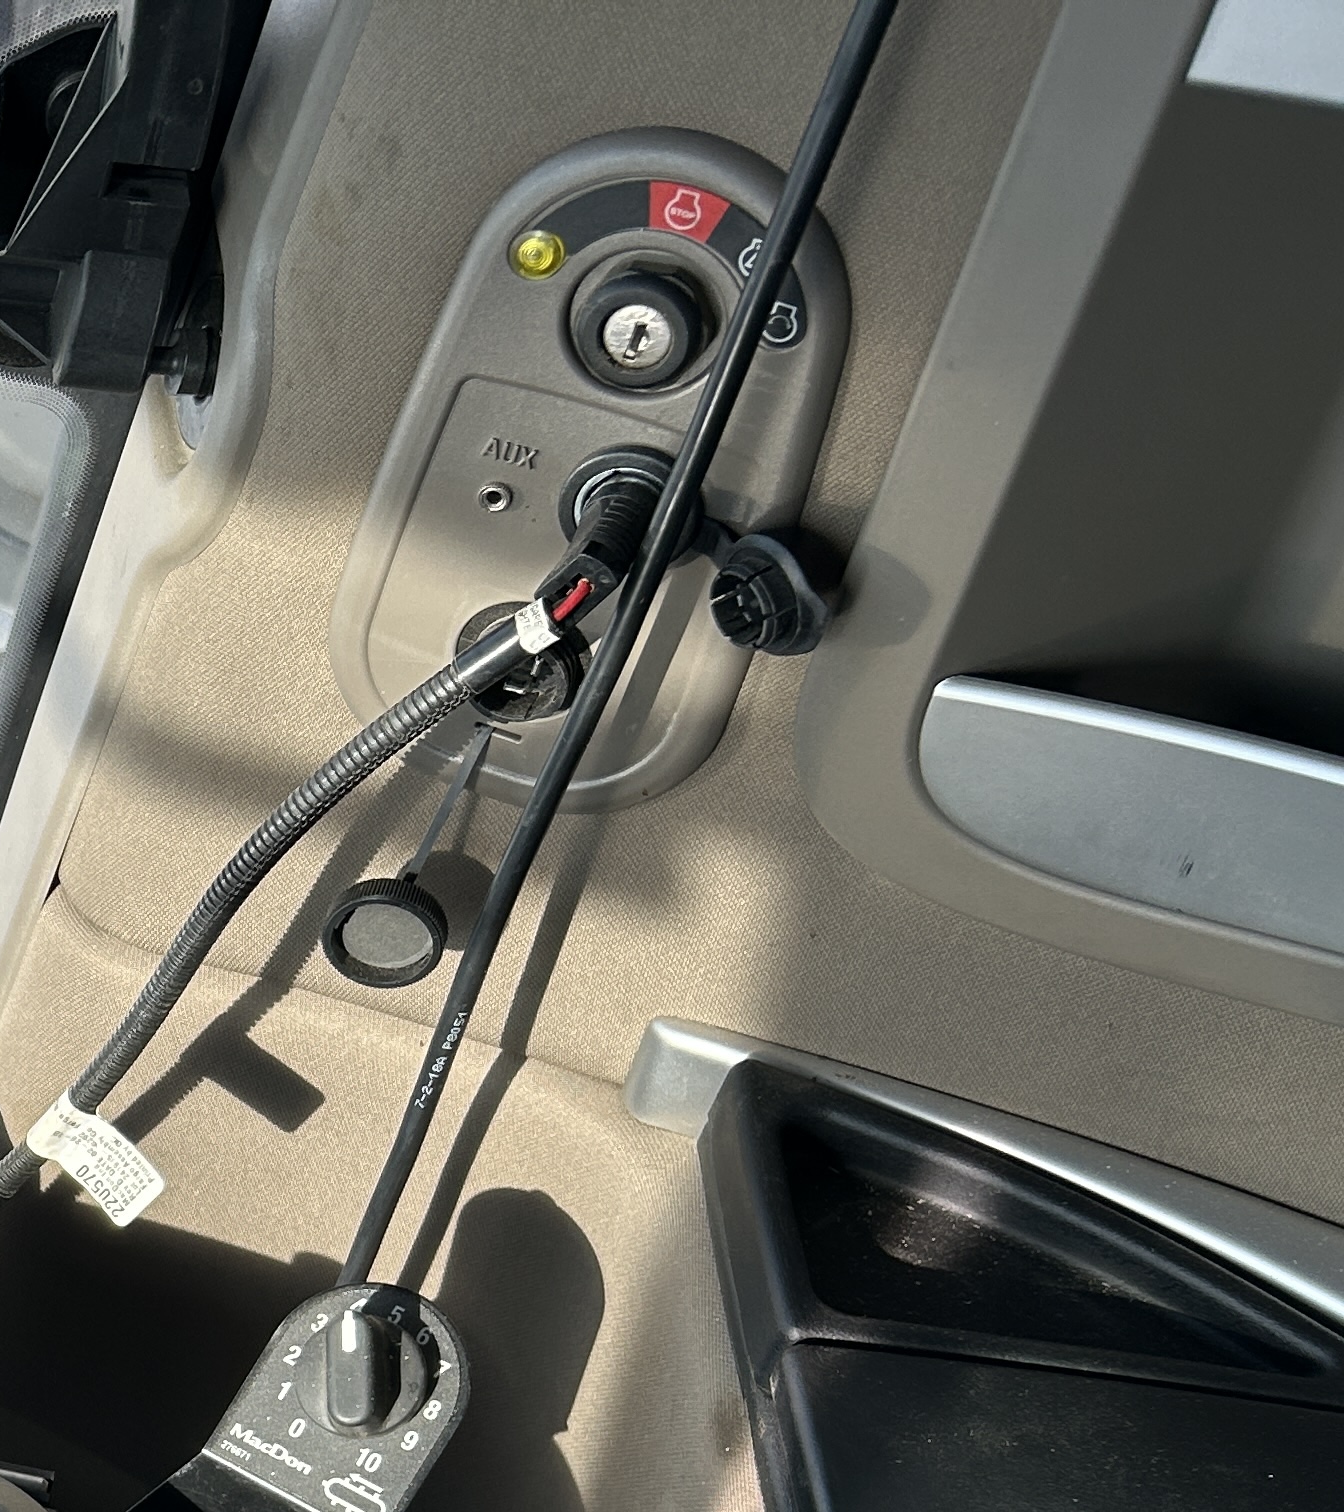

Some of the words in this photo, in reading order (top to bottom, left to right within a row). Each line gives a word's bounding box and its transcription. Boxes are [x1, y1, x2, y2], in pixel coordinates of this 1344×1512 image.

[670, 207, 696, 219] STOP
[480, 437, 539, 470] AUX
[310, 1313, 329, 1333] 3
[387, 1305, 405, 1325] 5
[416, 1327, 433, 1345] 6
[283, 1345, 302, 1366] 2
[433, 1359, 452, 1378] 7
[277, 1381, 292, 1400] 1
[423, 1400, 442, 1420] 8
[288, 1418, 306, 1438] 0
[229, 1422, 312, 1475] MacDon
[401, 1430, 419, 1451] 9
[355, 1448, 382, 1473] 10
